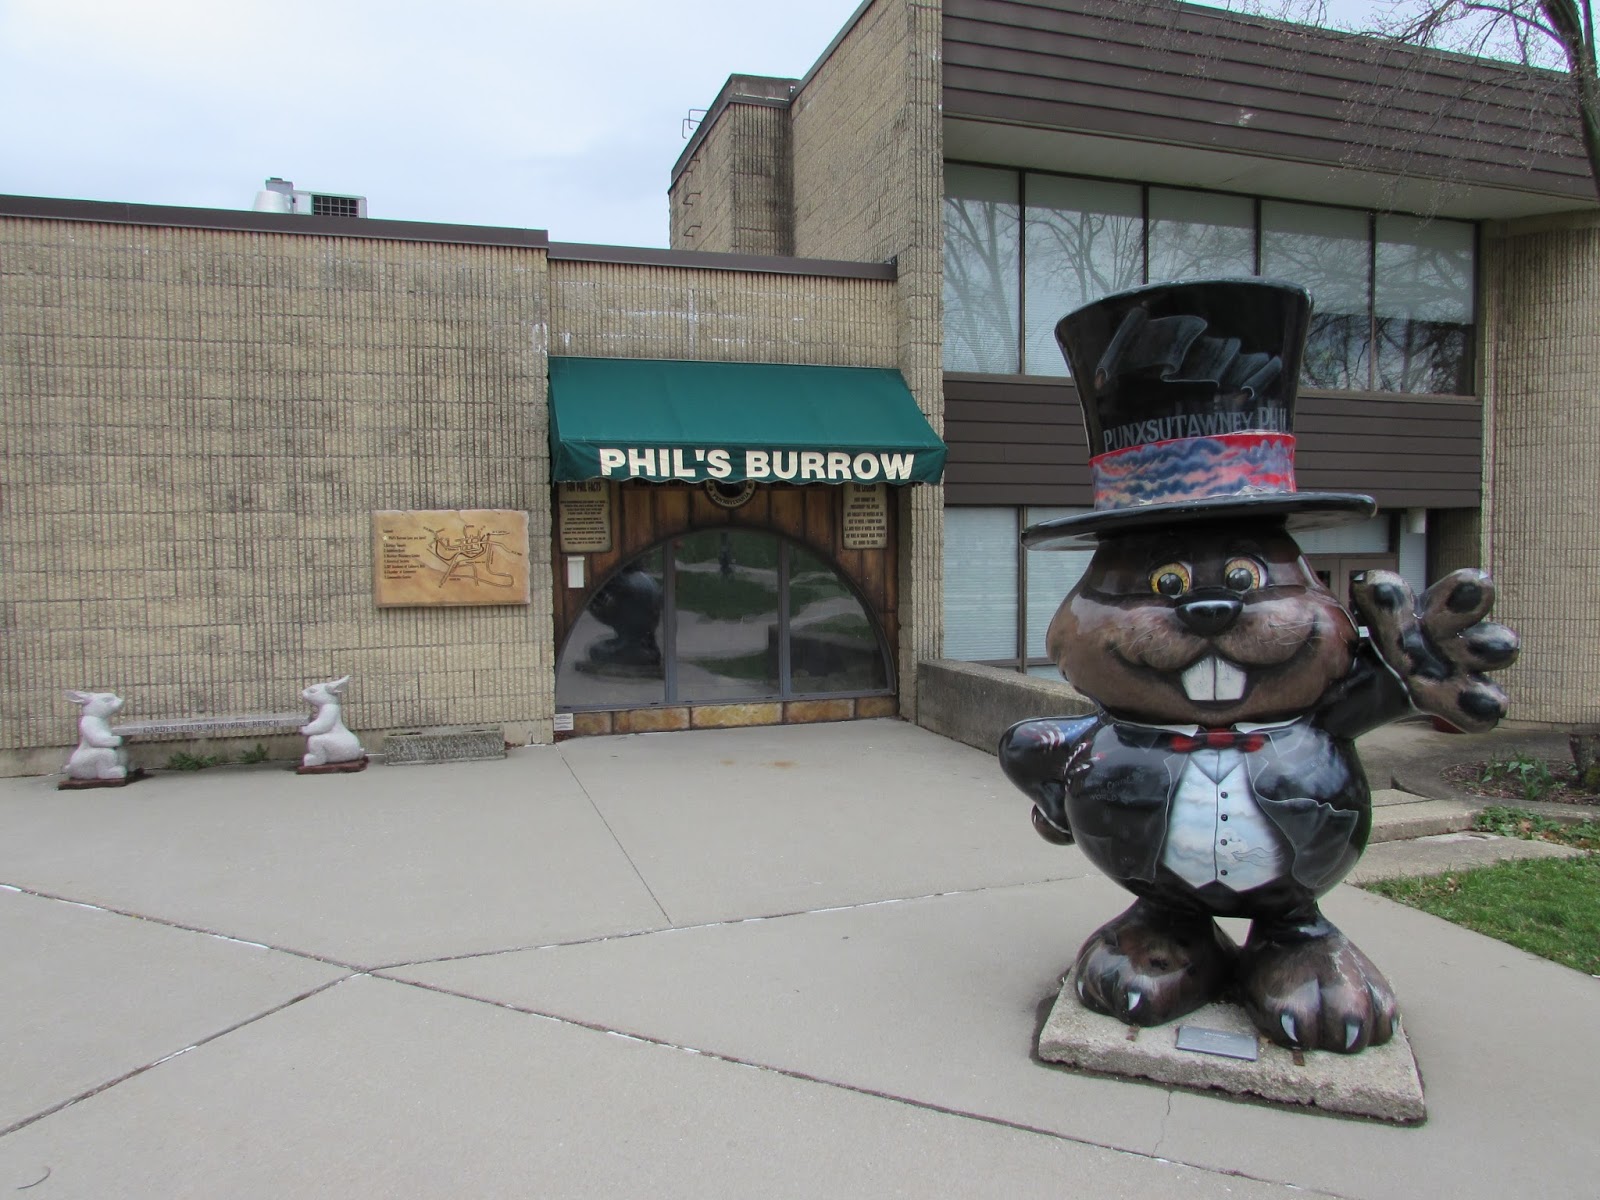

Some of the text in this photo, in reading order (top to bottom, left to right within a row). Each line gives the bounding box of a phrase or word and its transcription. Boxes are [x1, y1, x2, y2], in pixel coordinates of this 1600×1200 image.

[1103, 406, 1289, 452] PUNXSUTAWNEY PHIL
[599, 448, 915, 480] PHIL'S BURROW
[143, 720, 279, 734] GARDEN CLUB MEMORIAL BENCH
